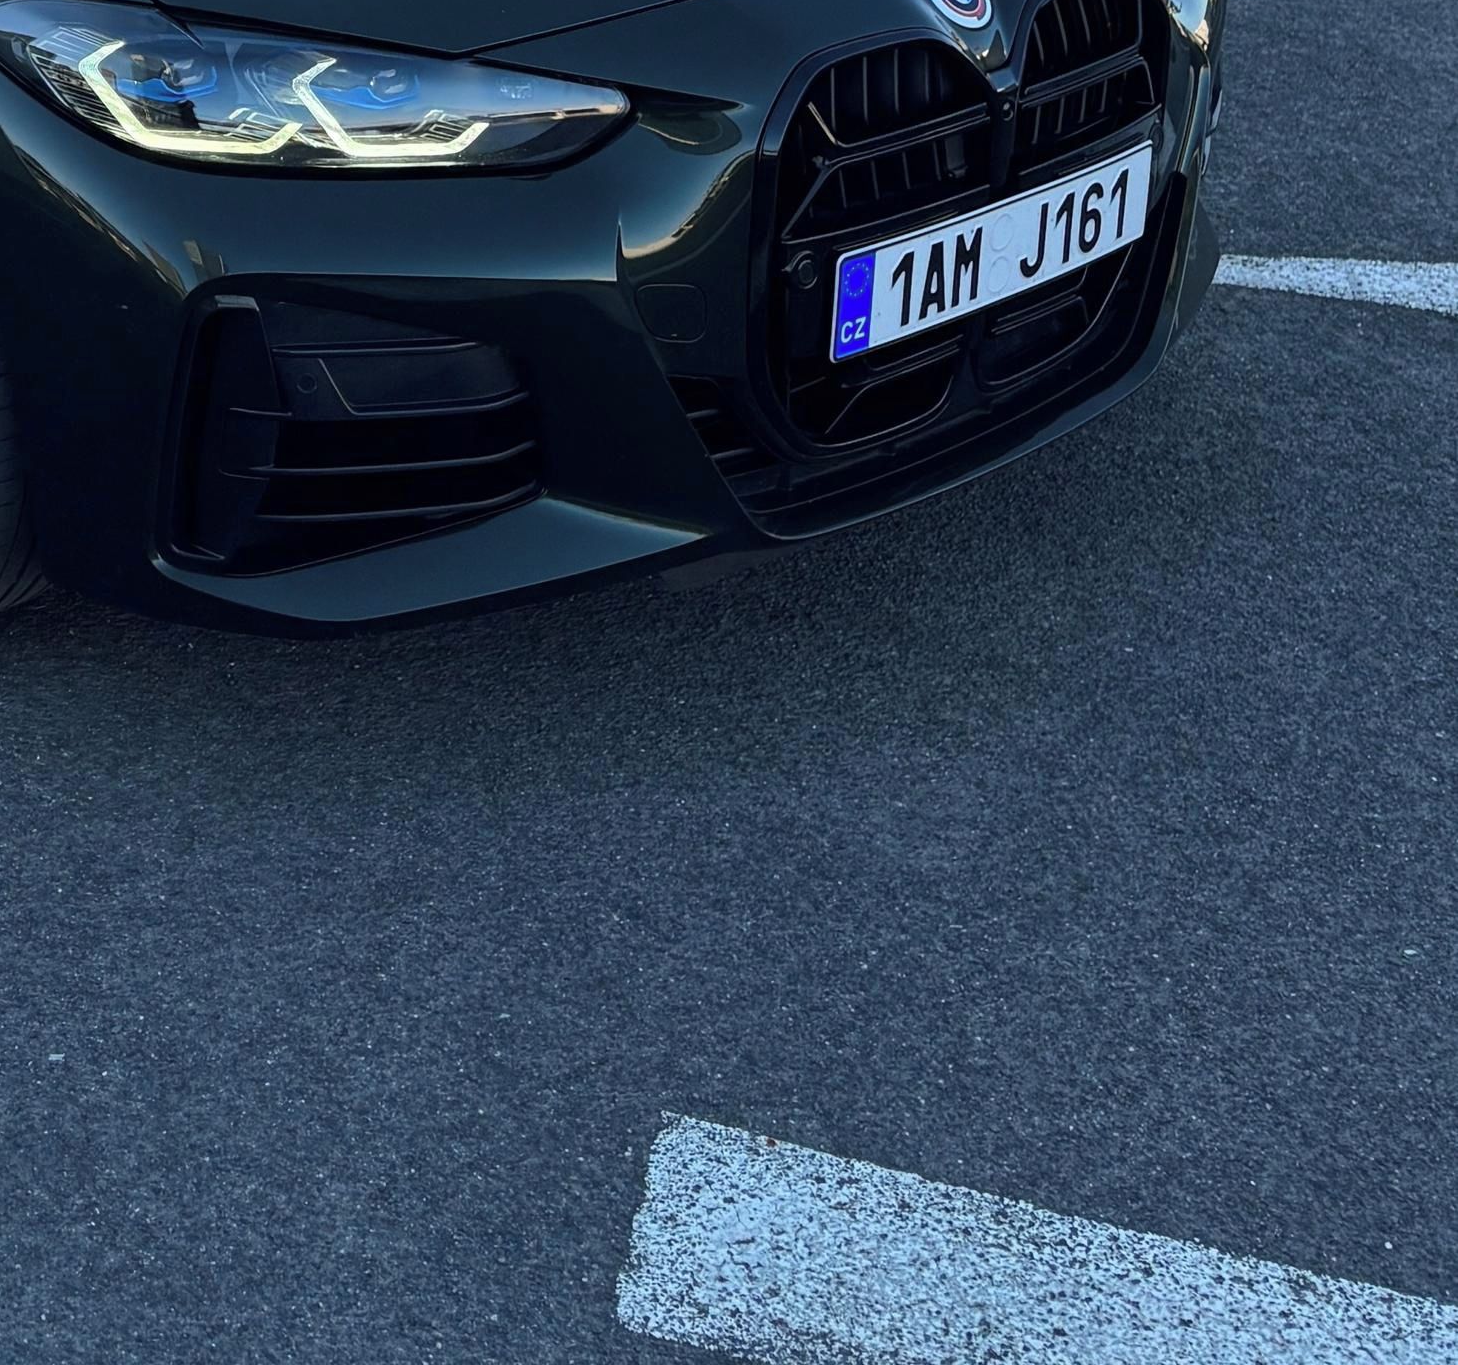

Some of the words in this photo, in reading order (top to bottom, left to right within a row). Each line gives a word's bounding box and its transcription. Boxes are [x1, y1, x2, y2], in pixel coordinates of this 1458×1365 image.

[892, 227, 983, 327] 1AM
[1020, 167, 1129, 279] J161
[841, 317, 867, 343] CZ
